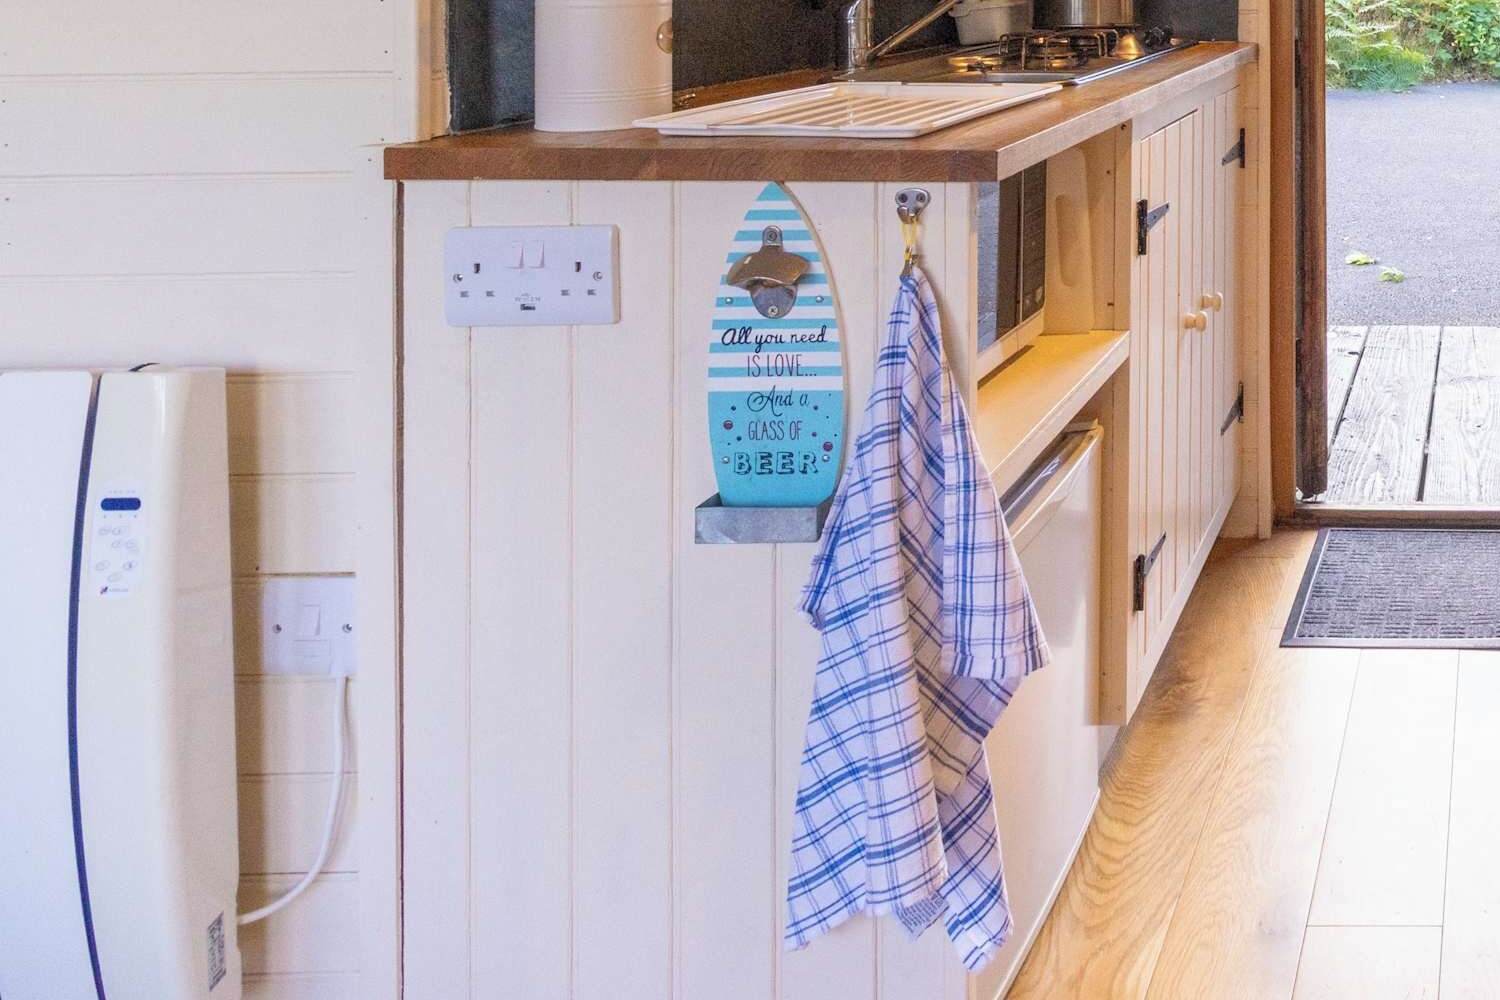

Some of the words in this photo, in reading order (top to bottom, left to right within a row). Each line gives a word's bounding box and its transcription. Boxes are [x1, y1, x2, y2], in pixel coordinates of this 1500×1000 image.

[722, 326, 752, 345] All
[755, 334, 785, 353] you
[790, 324, 828, 344] need
[747, 354, 761, 377] IS
[767, 353, 817, 377] LOVE...
[747, 384, 793, 417] And
[799, 393, 809, 406] a
[748, 420, 785, 441] GLASS
[789, 420, 803, 441] OF
[733, 451, 819, 475] BEER
